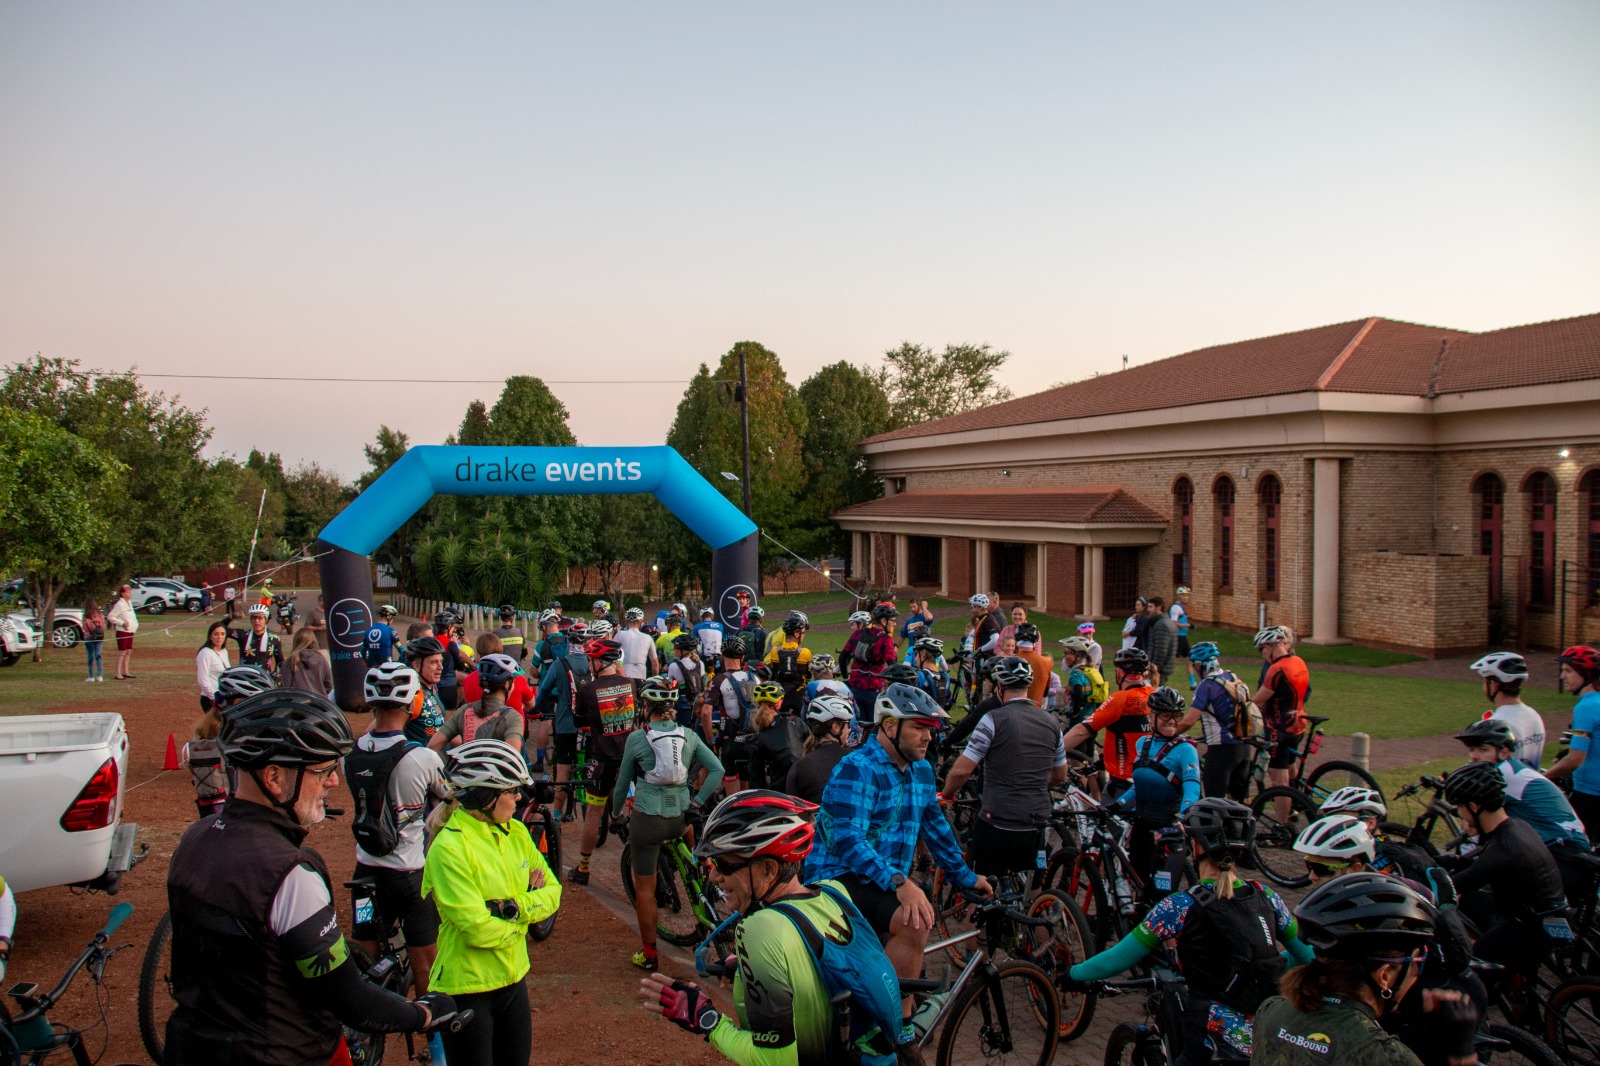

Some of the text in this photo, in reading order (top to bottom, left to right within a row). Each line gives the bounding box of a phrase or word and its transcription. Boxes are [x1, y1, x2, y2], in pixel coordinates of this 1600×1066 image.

[455, 456, 642, 482] drake events
[1156, 880, 1170, 890] 059
[357, 908, 372, 922] 092
